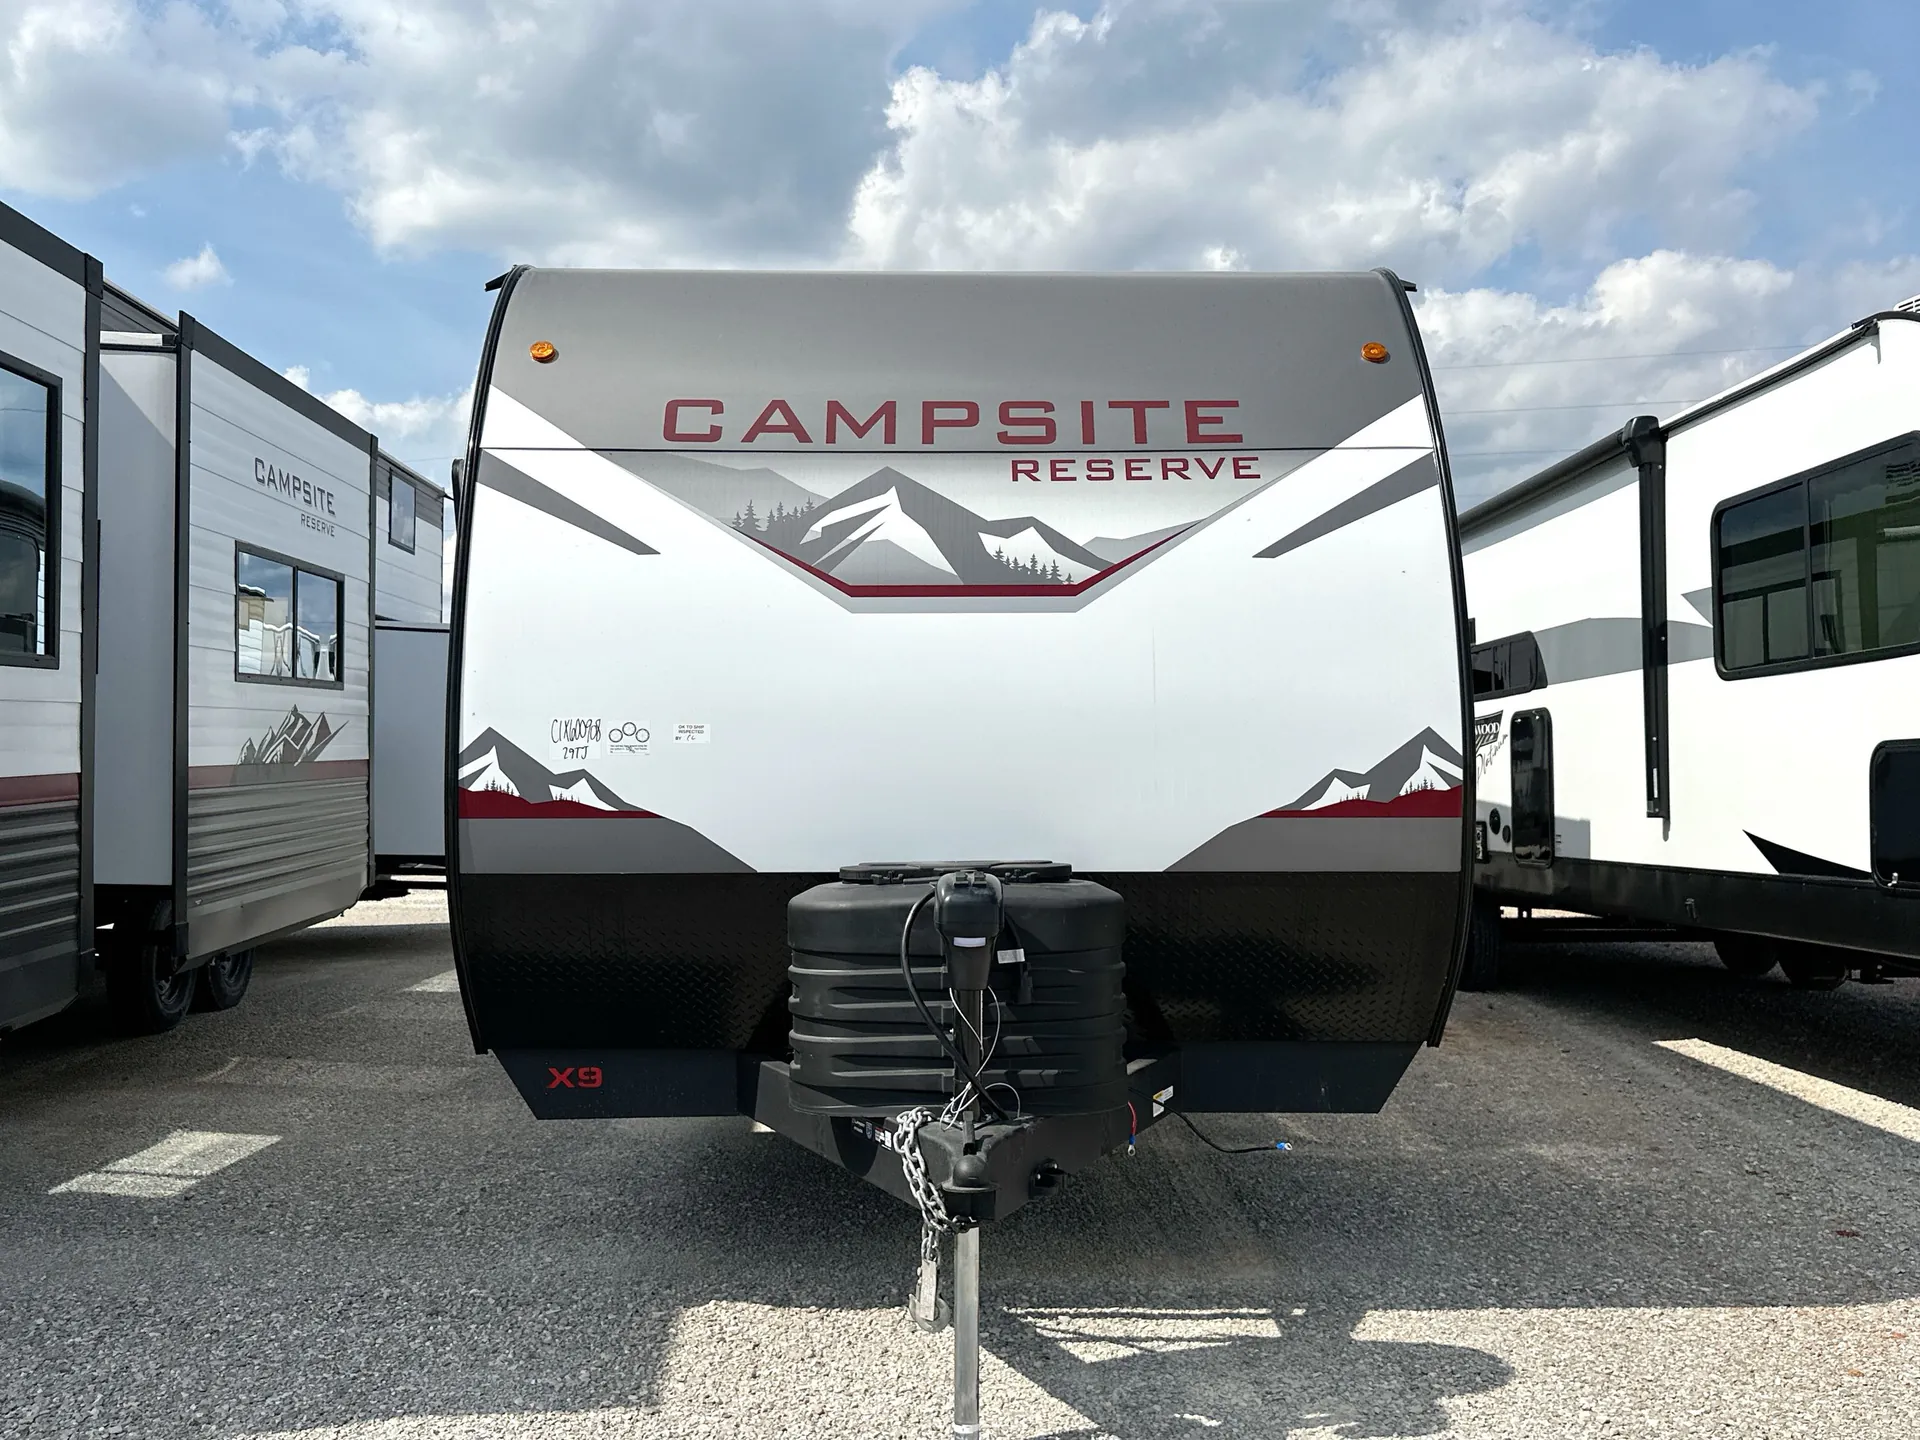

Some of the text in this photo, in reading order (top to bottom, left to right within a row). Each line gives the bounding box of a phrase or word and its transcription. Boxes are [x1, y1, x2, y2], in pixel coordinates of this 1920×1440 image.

[663, 399, 1243, 446] CAMPSITE
[1011, 457, 1261, 482] RESERVE
[255, 457, 336, 517] CAMPSITE
[300, 513, 336, 538] RESERVE
[547, 1067, 603, 1089] X9
